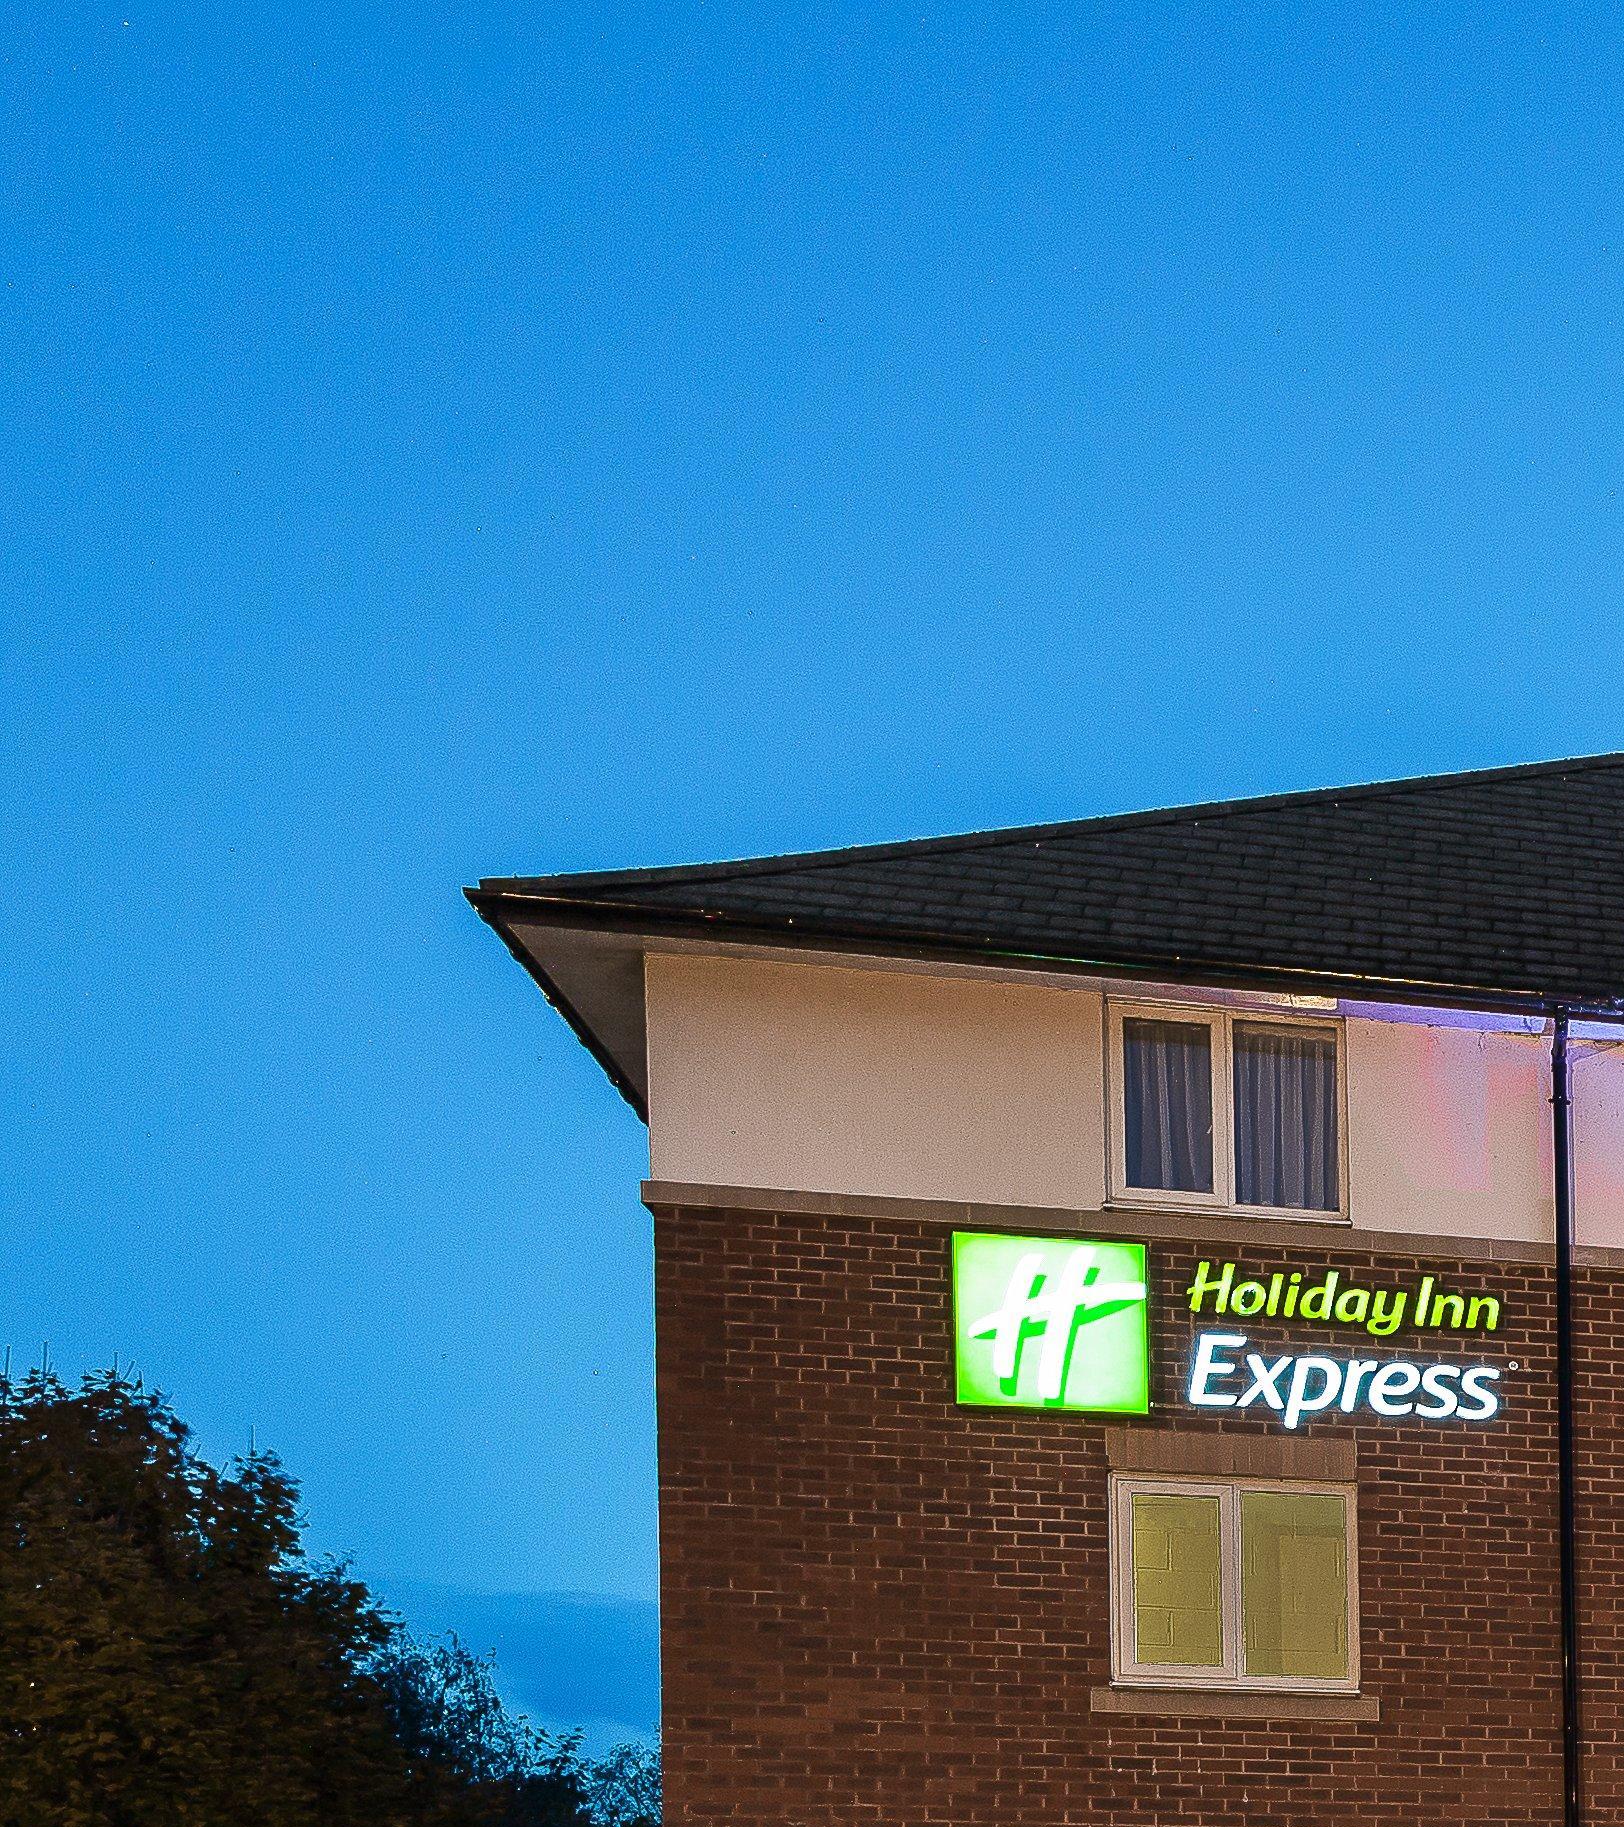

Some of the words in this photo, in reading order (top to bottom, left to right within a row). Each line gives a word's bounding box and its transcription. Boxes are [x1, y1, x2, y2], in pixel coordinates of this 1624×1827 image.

[1187, 1260, 1405, 1336] Holiday
[1414, 1276, 1502, 1331] Inn
[1188, 1332, 1503, 1431] Express
